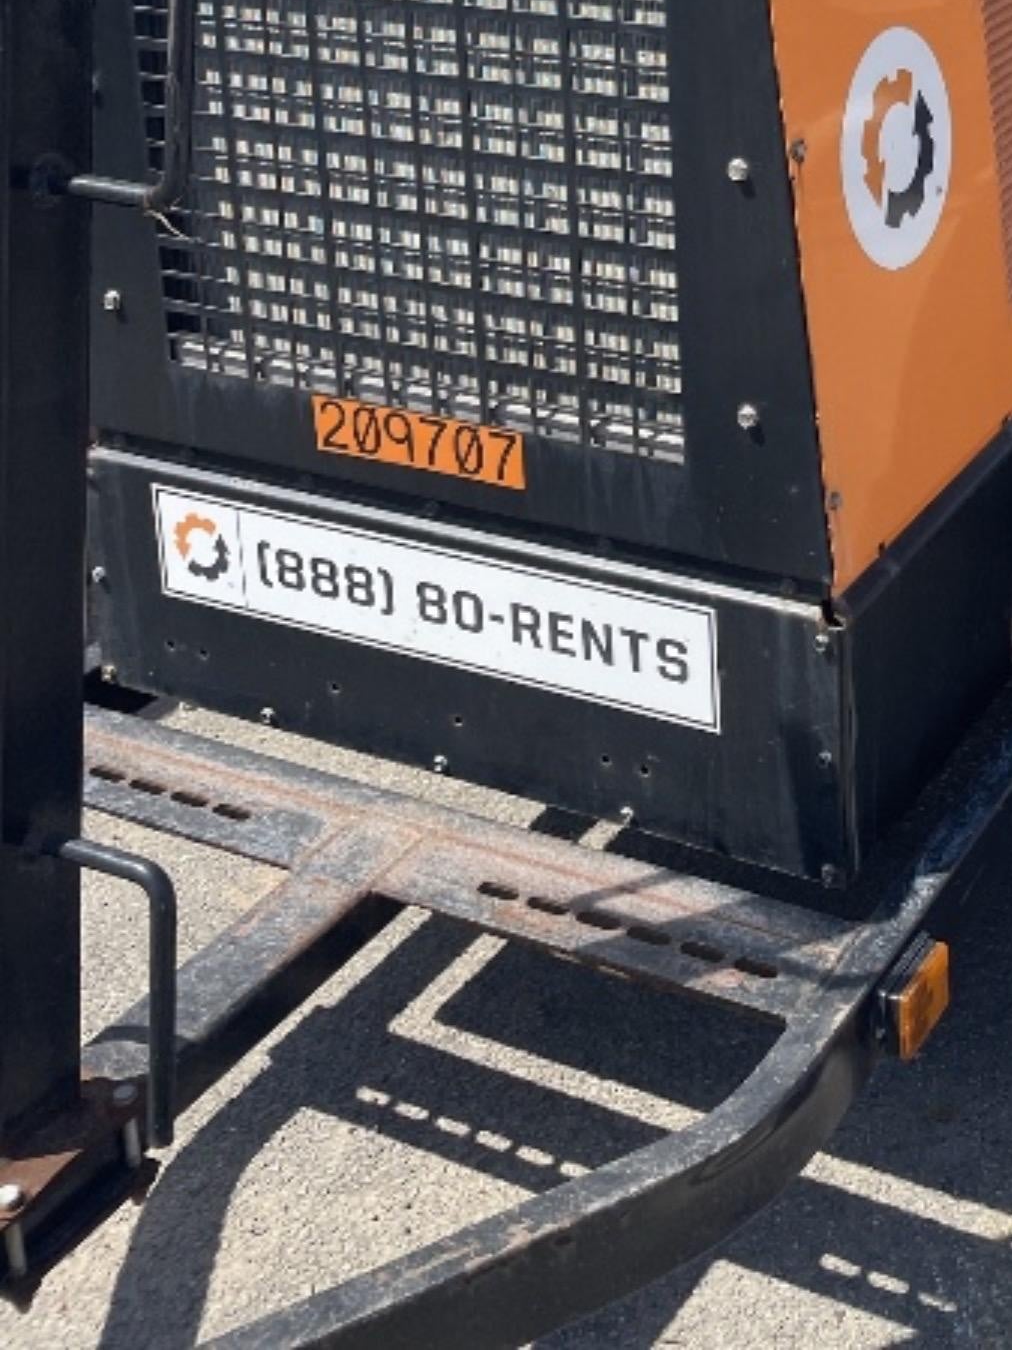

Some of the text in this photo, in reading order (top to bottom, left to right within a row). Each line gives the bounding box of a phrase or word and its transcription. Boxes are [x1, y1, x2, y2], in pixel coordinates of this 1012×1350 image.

[319, 400, 519, 482] 209707
[257, 539, 689, 685] (888) 80-RENTS
